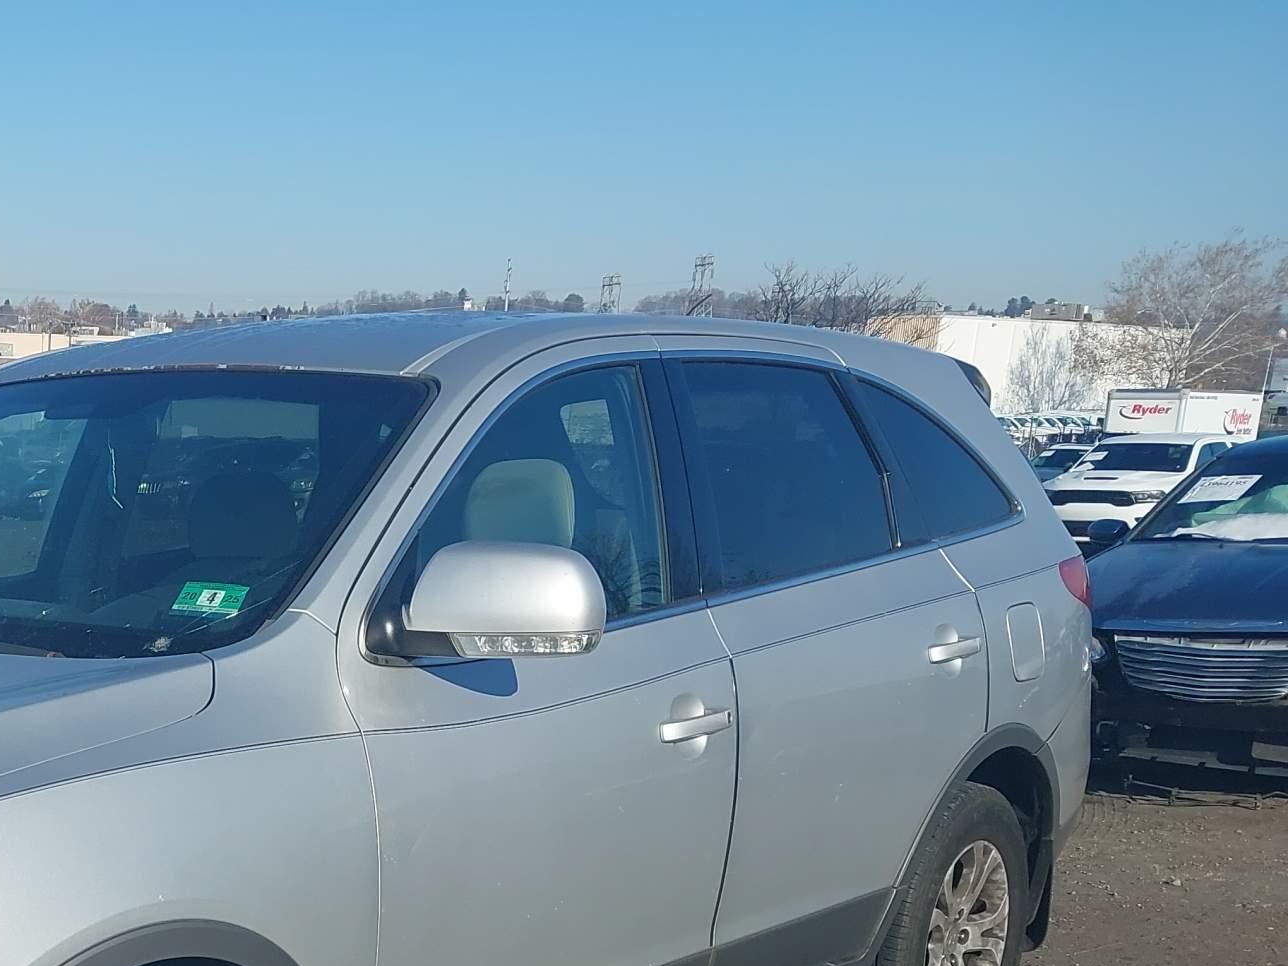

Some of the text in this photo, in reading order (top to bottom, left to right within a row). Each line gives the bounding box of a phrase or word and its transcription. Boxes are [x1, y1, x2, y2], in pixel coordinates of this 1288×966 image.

[1131, 404, 1172, 417] Ryder
[1230, 409, 1252, 427] Ryder
[183, 592, 240, 604] 20 4 25
